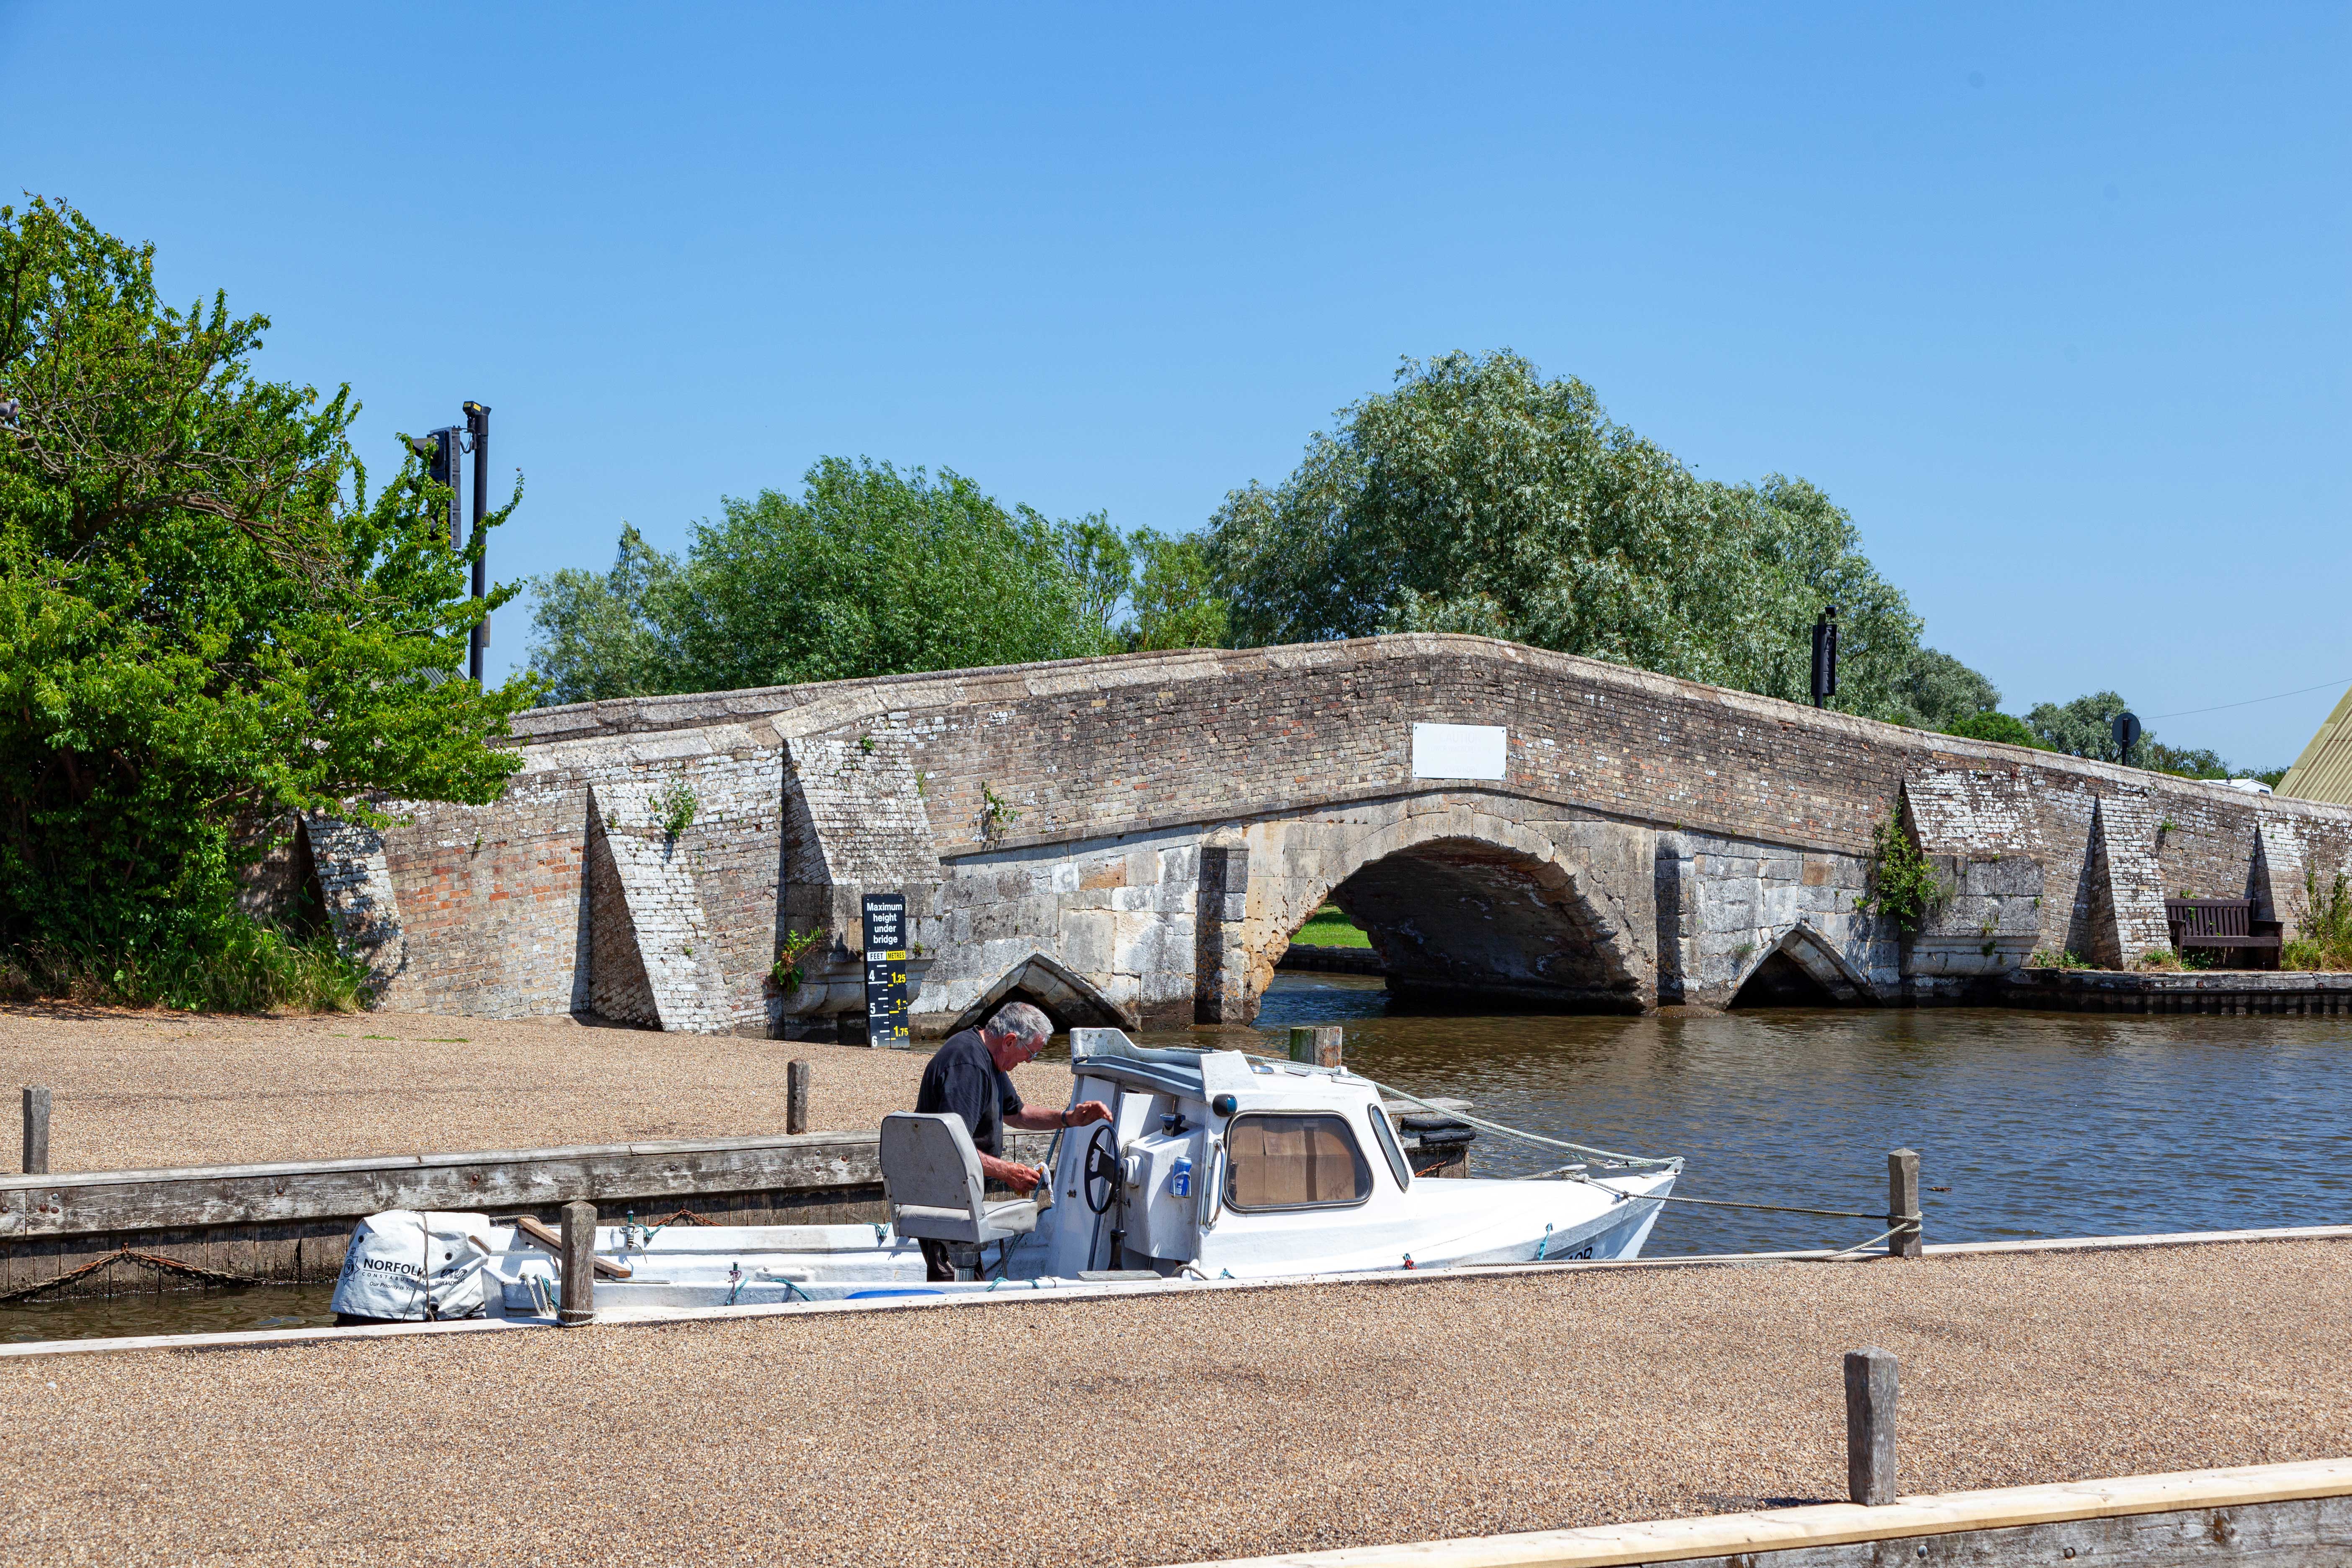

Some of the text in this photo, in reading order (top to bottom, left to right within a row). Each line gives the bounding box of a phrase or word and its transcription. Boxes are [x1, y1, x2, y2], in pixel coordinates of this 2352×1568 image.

[867, 903, 903, 911] Maximum
[873, 913, 897, 923] height
[874, 924, 896, 932] under
[873, 935, 898, 945] bridge
[869, 970, 875, 981] 4
[891, 972, 906, 983] 1.25
[870, 1003, 876, 1014] 5
[893, 1025, 908, 1037] 1.75
[872, 1035, 878, 1047] 6
[364, 1258, 425, 1278] NORFOLK
